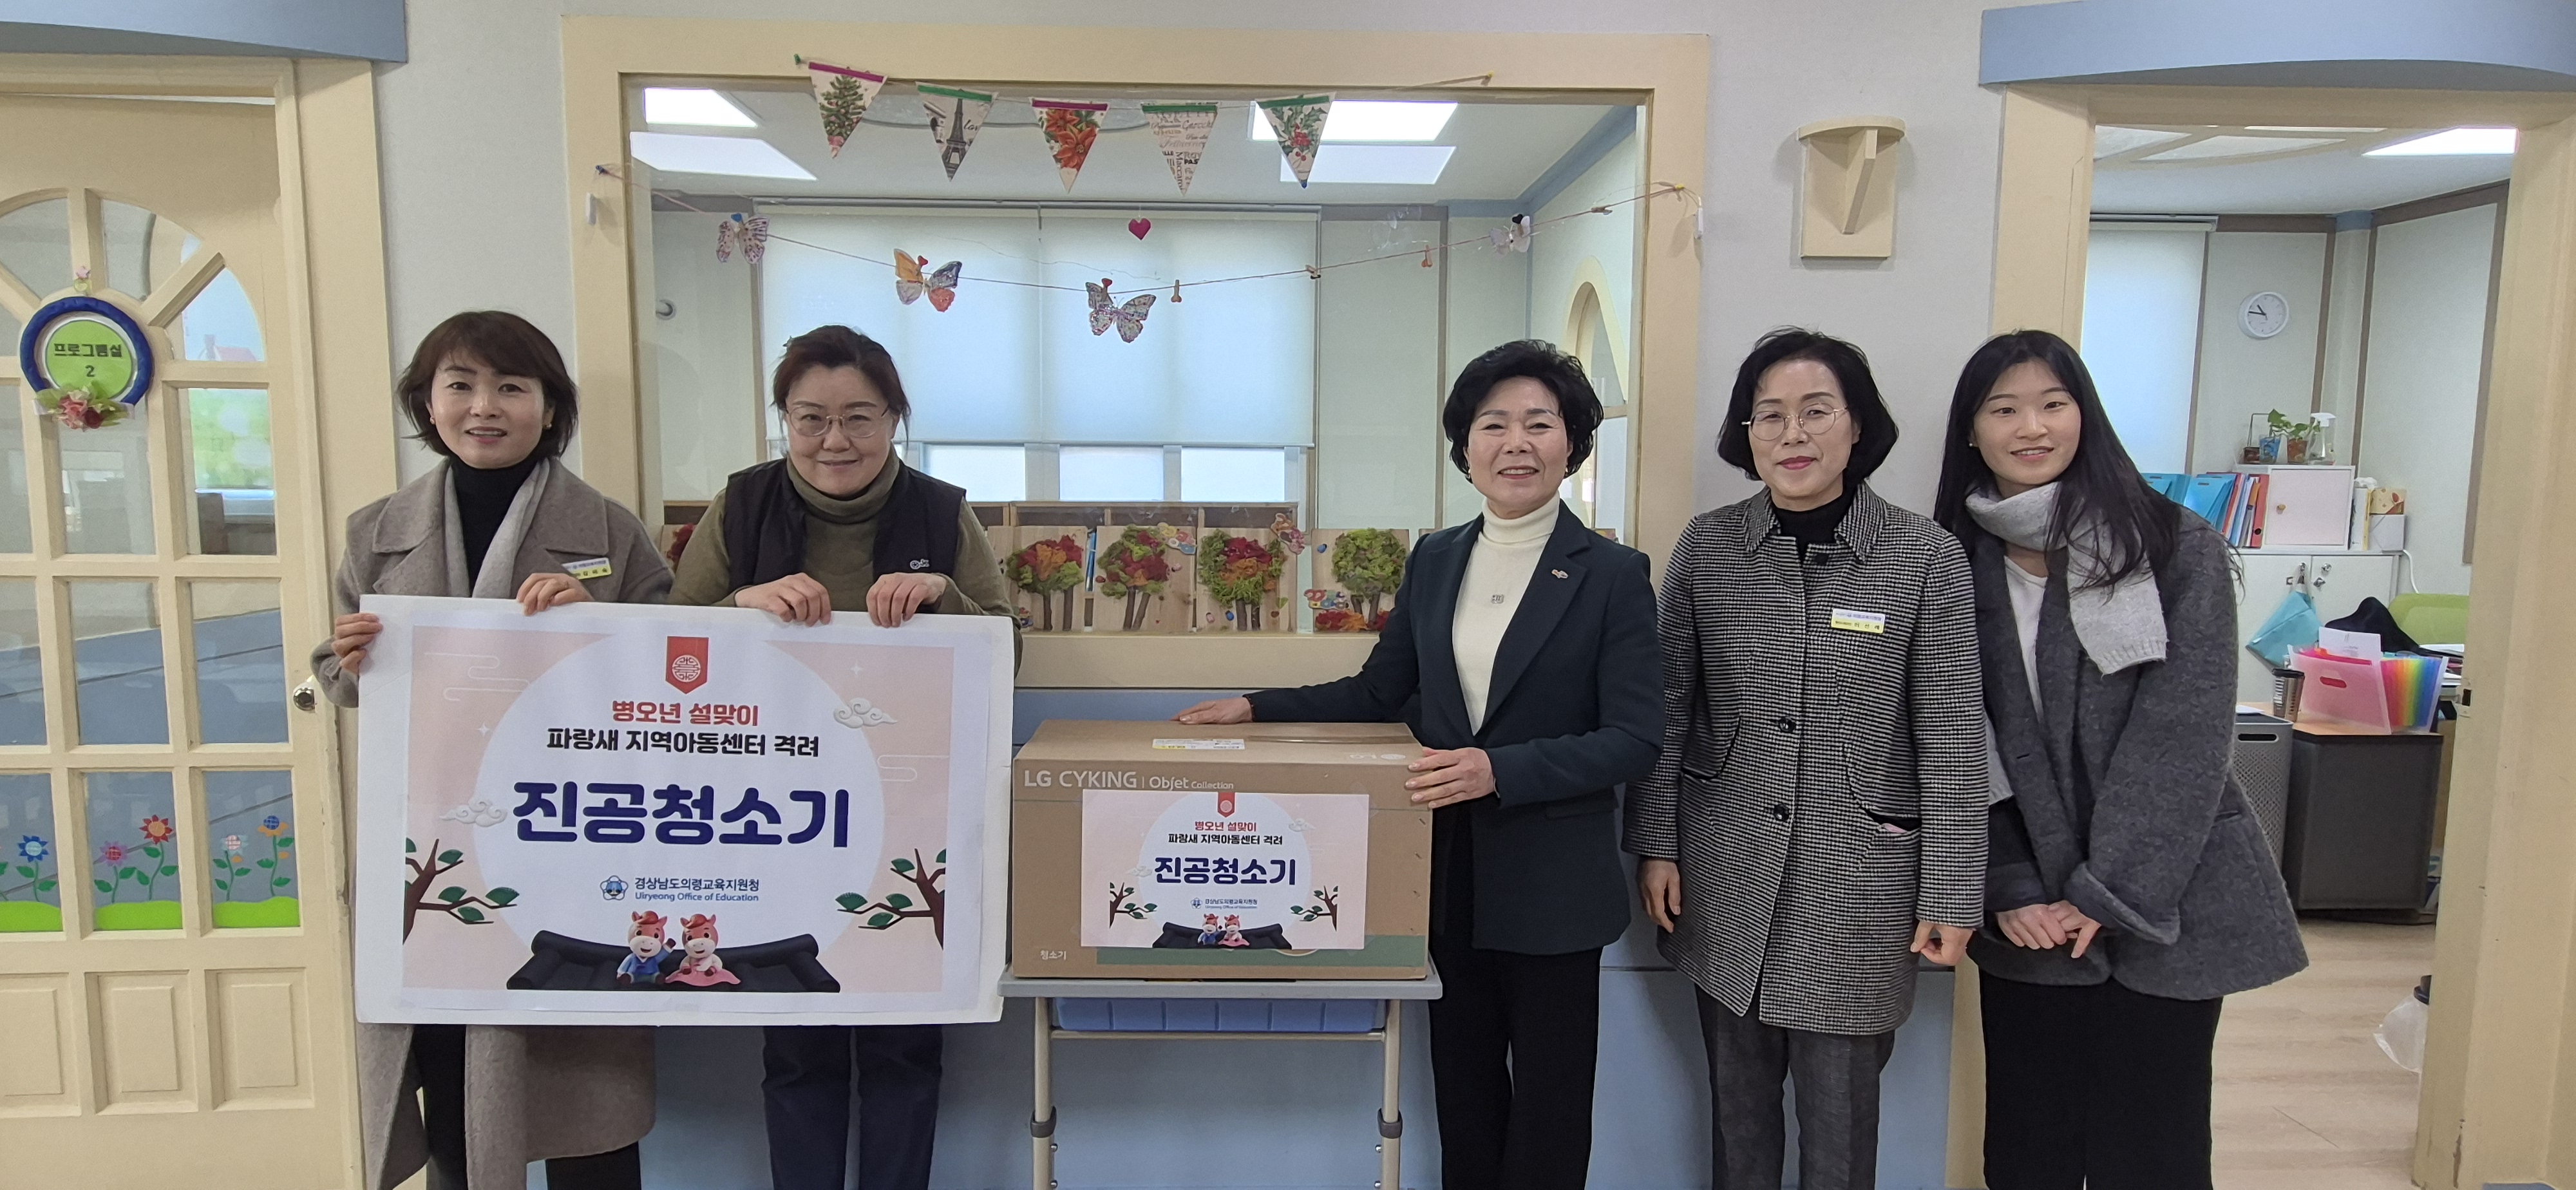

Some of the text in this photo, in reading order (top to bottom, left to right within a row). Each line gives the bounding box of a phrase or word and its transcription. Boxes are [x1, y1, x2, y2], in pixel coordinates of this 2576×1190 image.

[53, 343, 122, 357] 프로그램실
[85, 364, 95, 377] 2
[612, 700, 759, 726] 병오년 설맞이
[546, 728, 819, 757] 파랑새 지역아동센터 격려
[1024, 770, 1234, 791] LG CYKING Objet Collection
[513, 781, 849, 848] 진공청소기
[1195, 821, 1256, 832] 병오년 설맞이
[1168, 833, 1283, 845] 파랑새 지역아동센터 격려
[1154, 857, 1296, 885] 진공청소기
[634, 877, 760, 892] 경상남도의령교육지원청
[635, 891, 759, 902] Uiryeong Office of Education
[1040, 950, 1066, 960] 청소기
